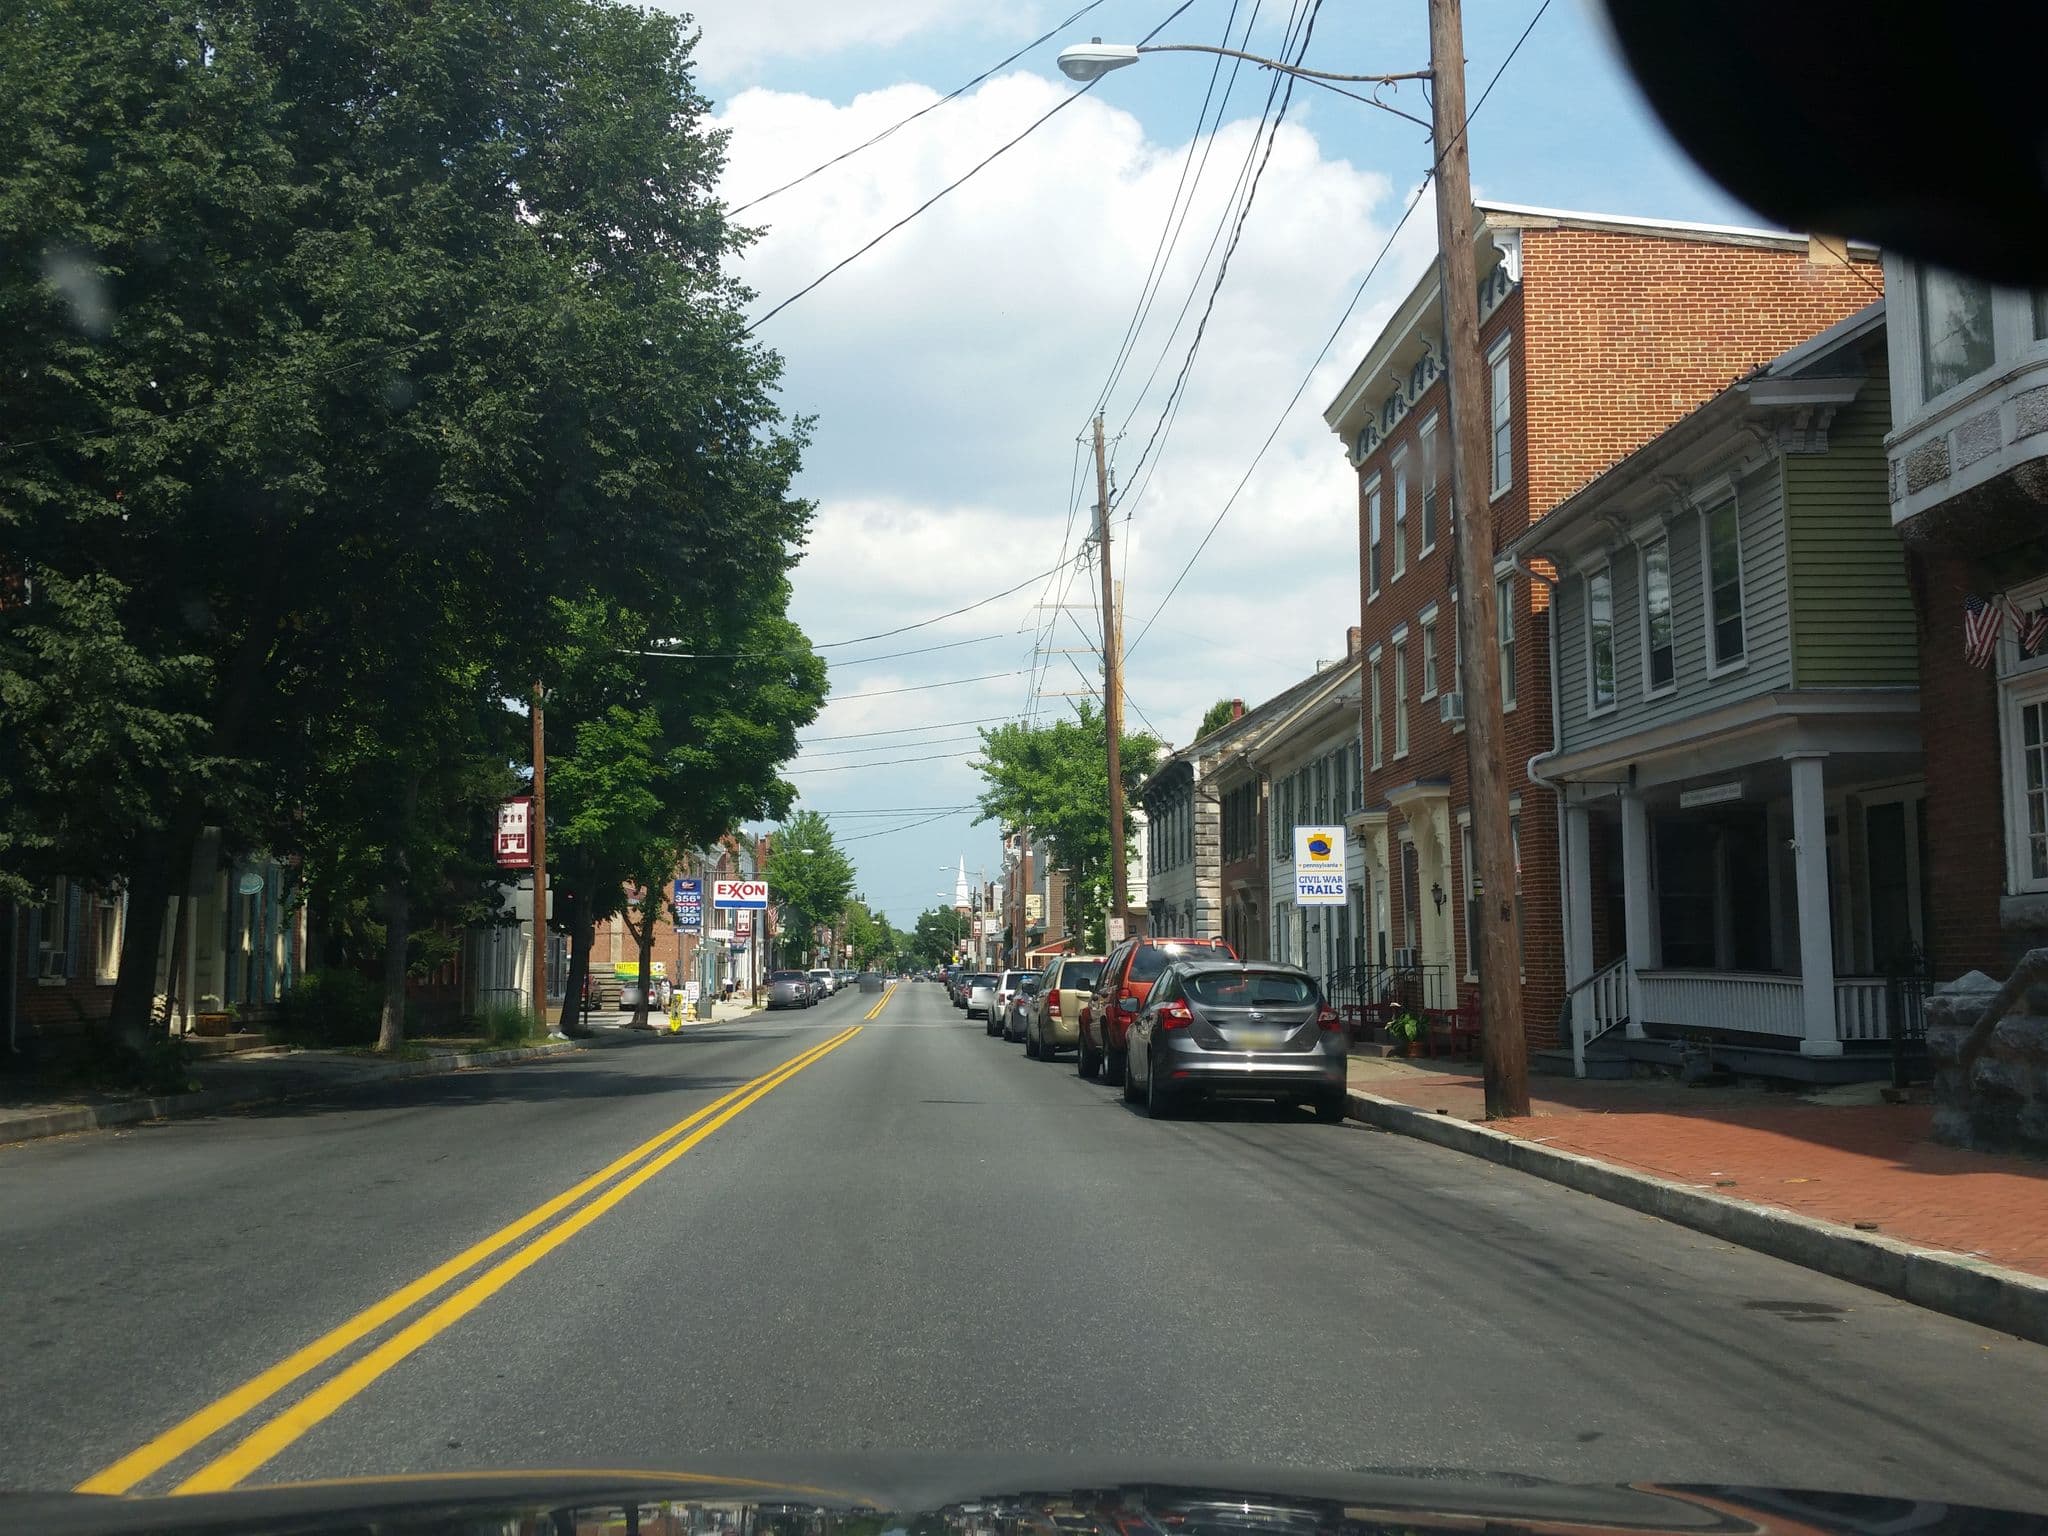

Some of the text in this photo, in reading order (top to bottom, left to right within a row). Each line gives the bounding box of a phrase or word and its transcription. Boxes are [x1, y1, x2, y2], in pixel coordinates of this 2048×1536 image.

[1299, 876, 1343, 884] CIVIL WAR
[718, 883, 765, 899] EXXON
[1299, 885, 1344, 894] TRAILS
